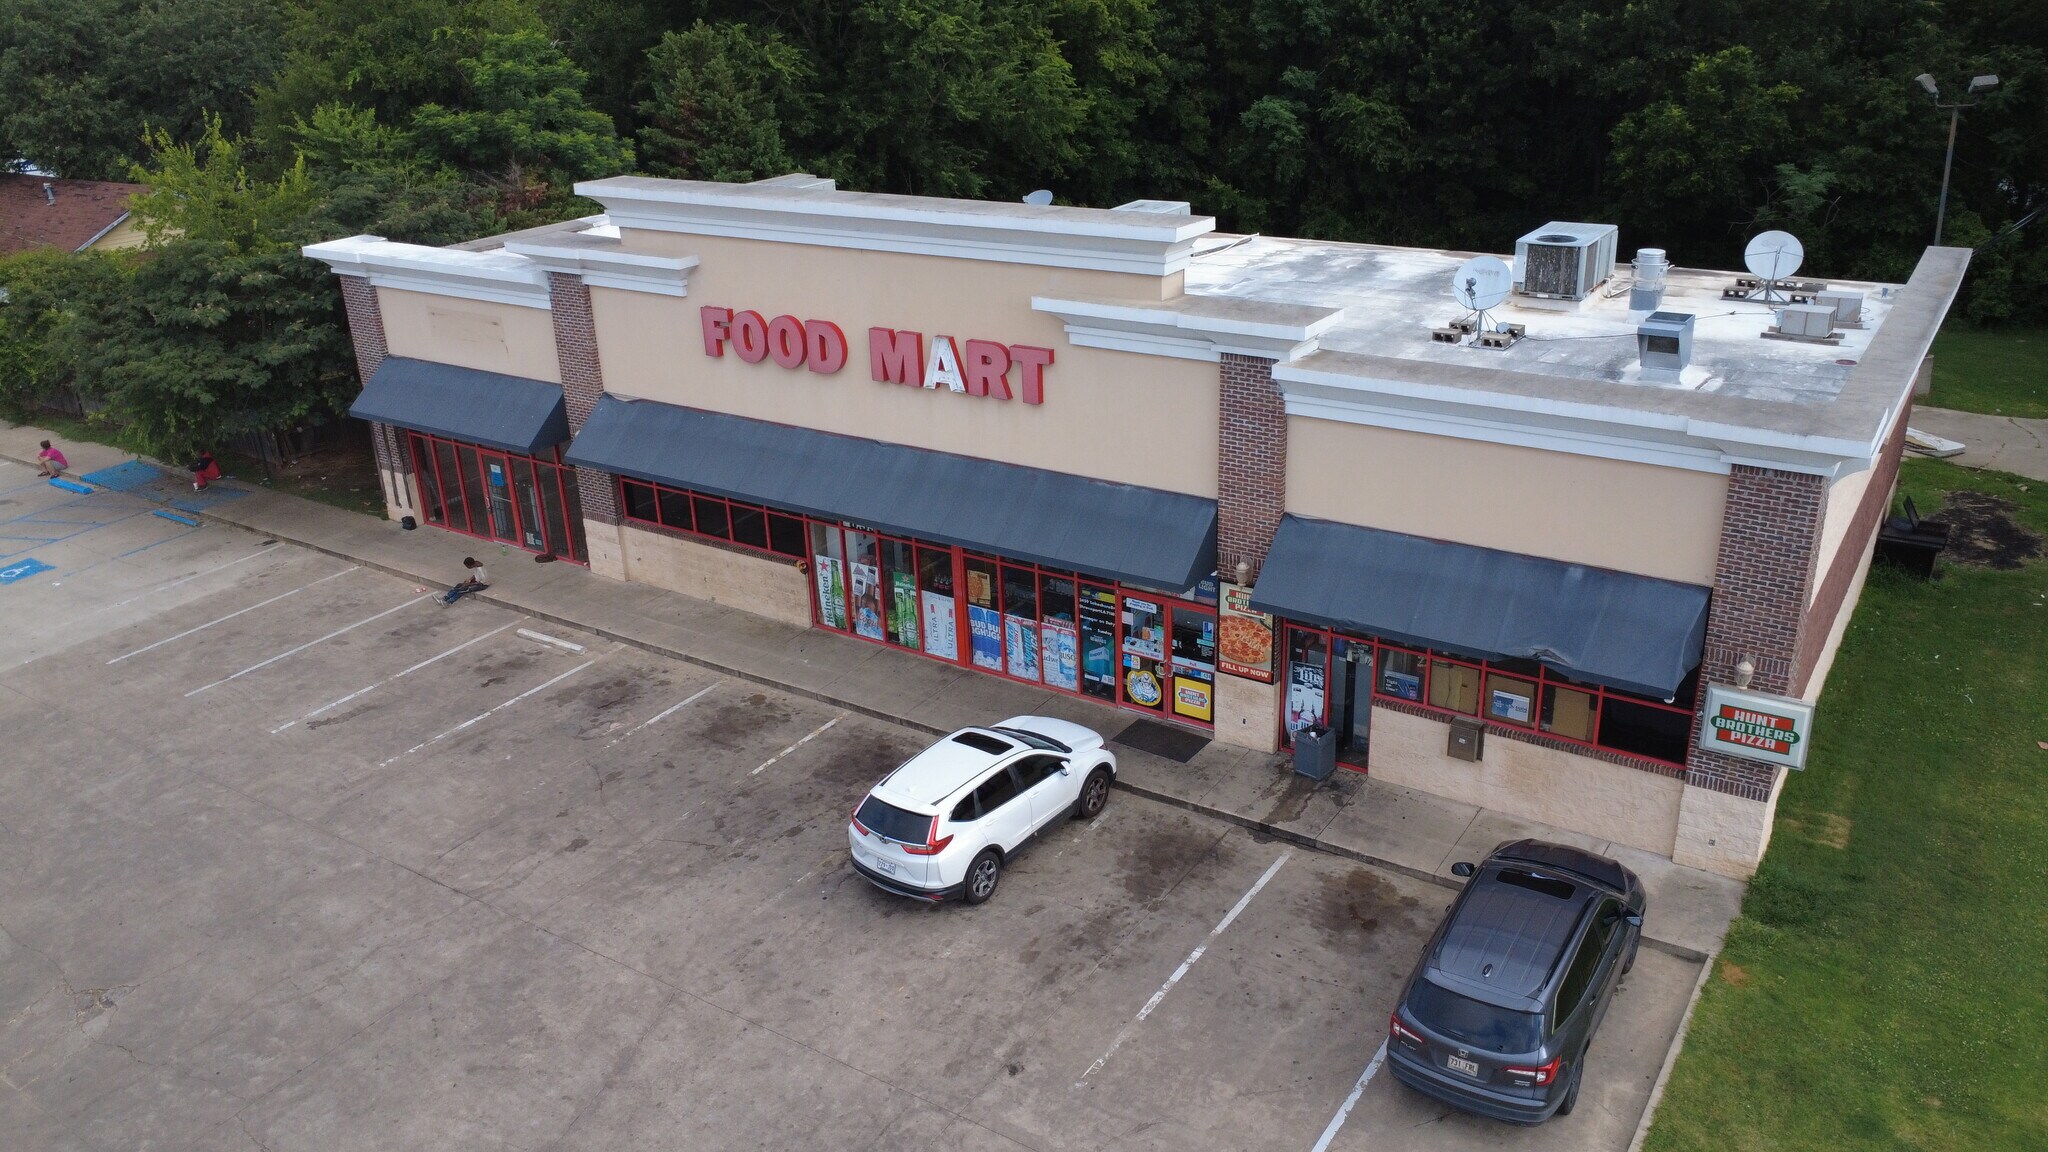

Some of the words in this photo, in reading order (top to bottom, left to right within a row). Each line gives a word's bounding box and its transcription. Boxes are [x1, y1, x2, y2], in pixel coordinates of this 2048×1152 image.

[701, 305, 848, 374] FOOD
[869, 327, 1055, 405] MART
[1198, 583, 1216, 593] LIGHT
[822, 576, 834, 624] Heineken
[1221, 662, 1238, 672] FILL
[1238, 665, 1249, 673] UP
[1249, 668, 1269, 678] NOW
[1734, 710, 1779, 728] HUNT
[1715, 717, 1795, 743] BROTHERS
[1730, 731, 1776, 749] PIZZA
